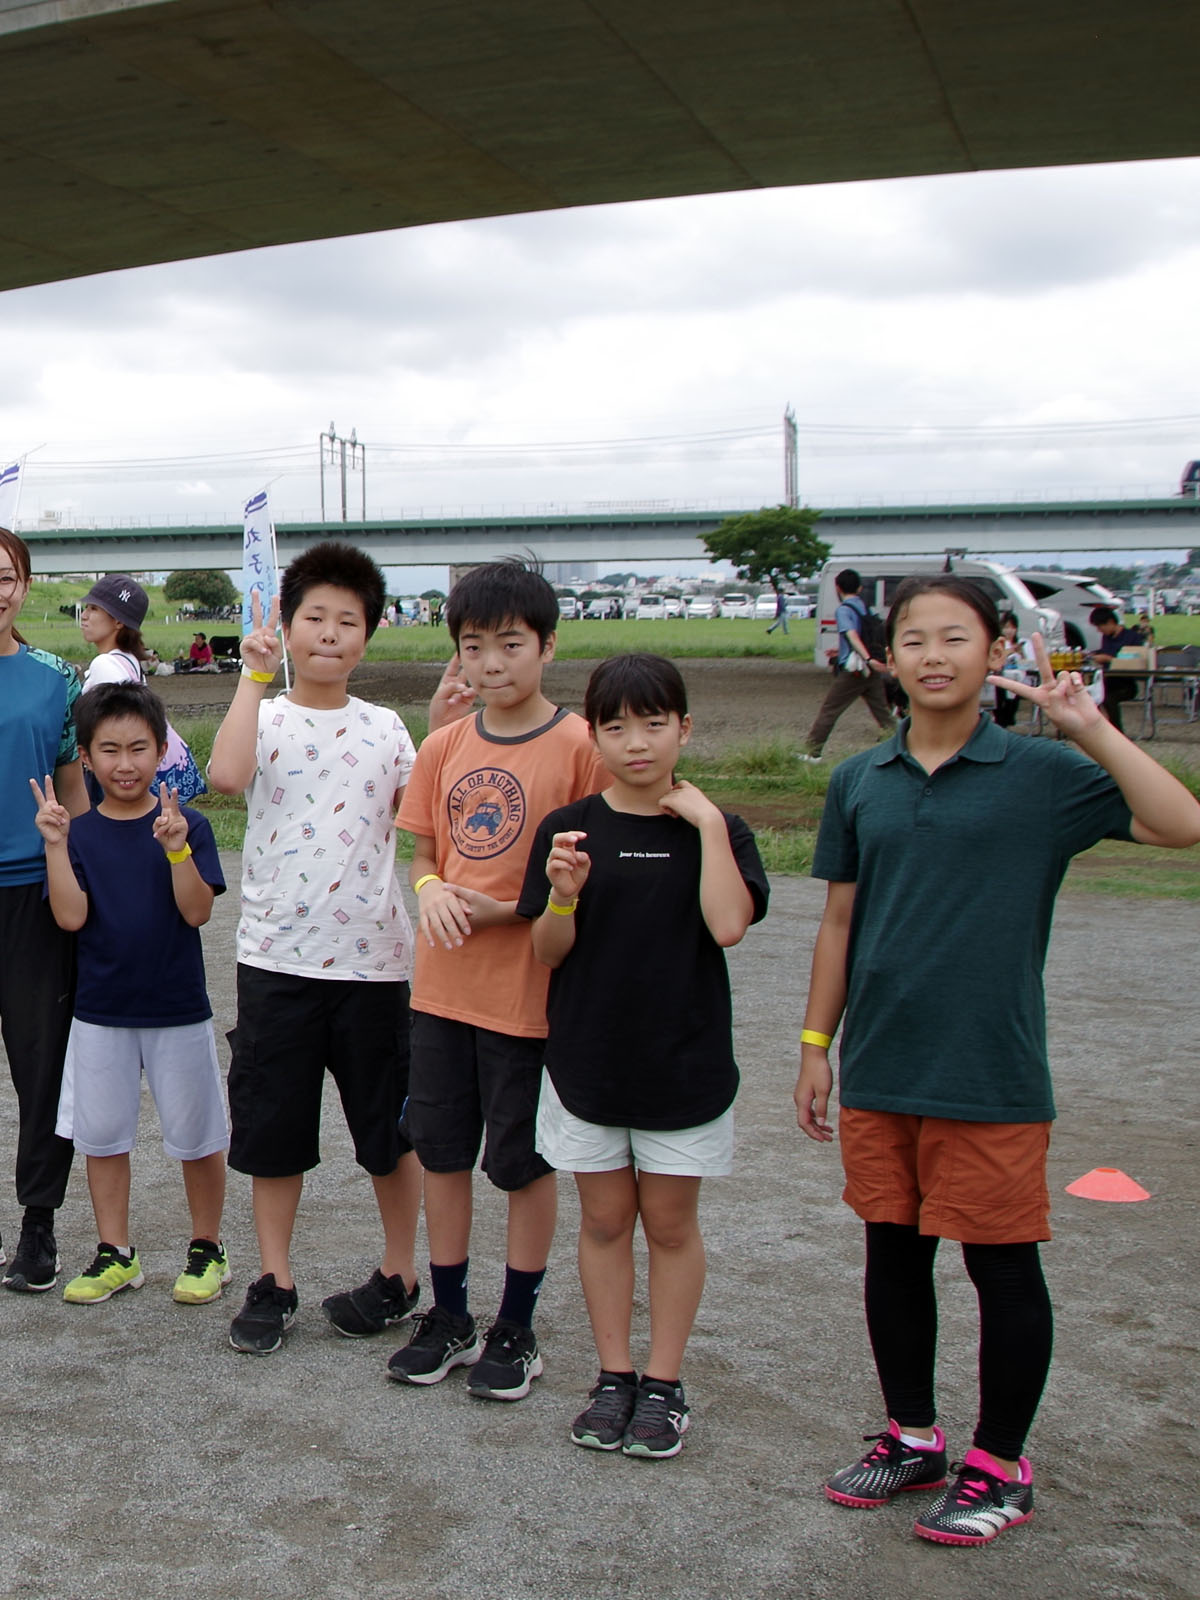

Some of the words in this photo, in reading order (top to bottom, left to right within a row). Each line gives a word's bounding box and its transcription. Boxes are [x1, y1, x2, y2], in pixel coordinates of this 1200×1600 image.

[452, 787, 467, 812] ALL
[467, 774, 484, 788] OR
[488, 772, 520, 822] NOTHING
